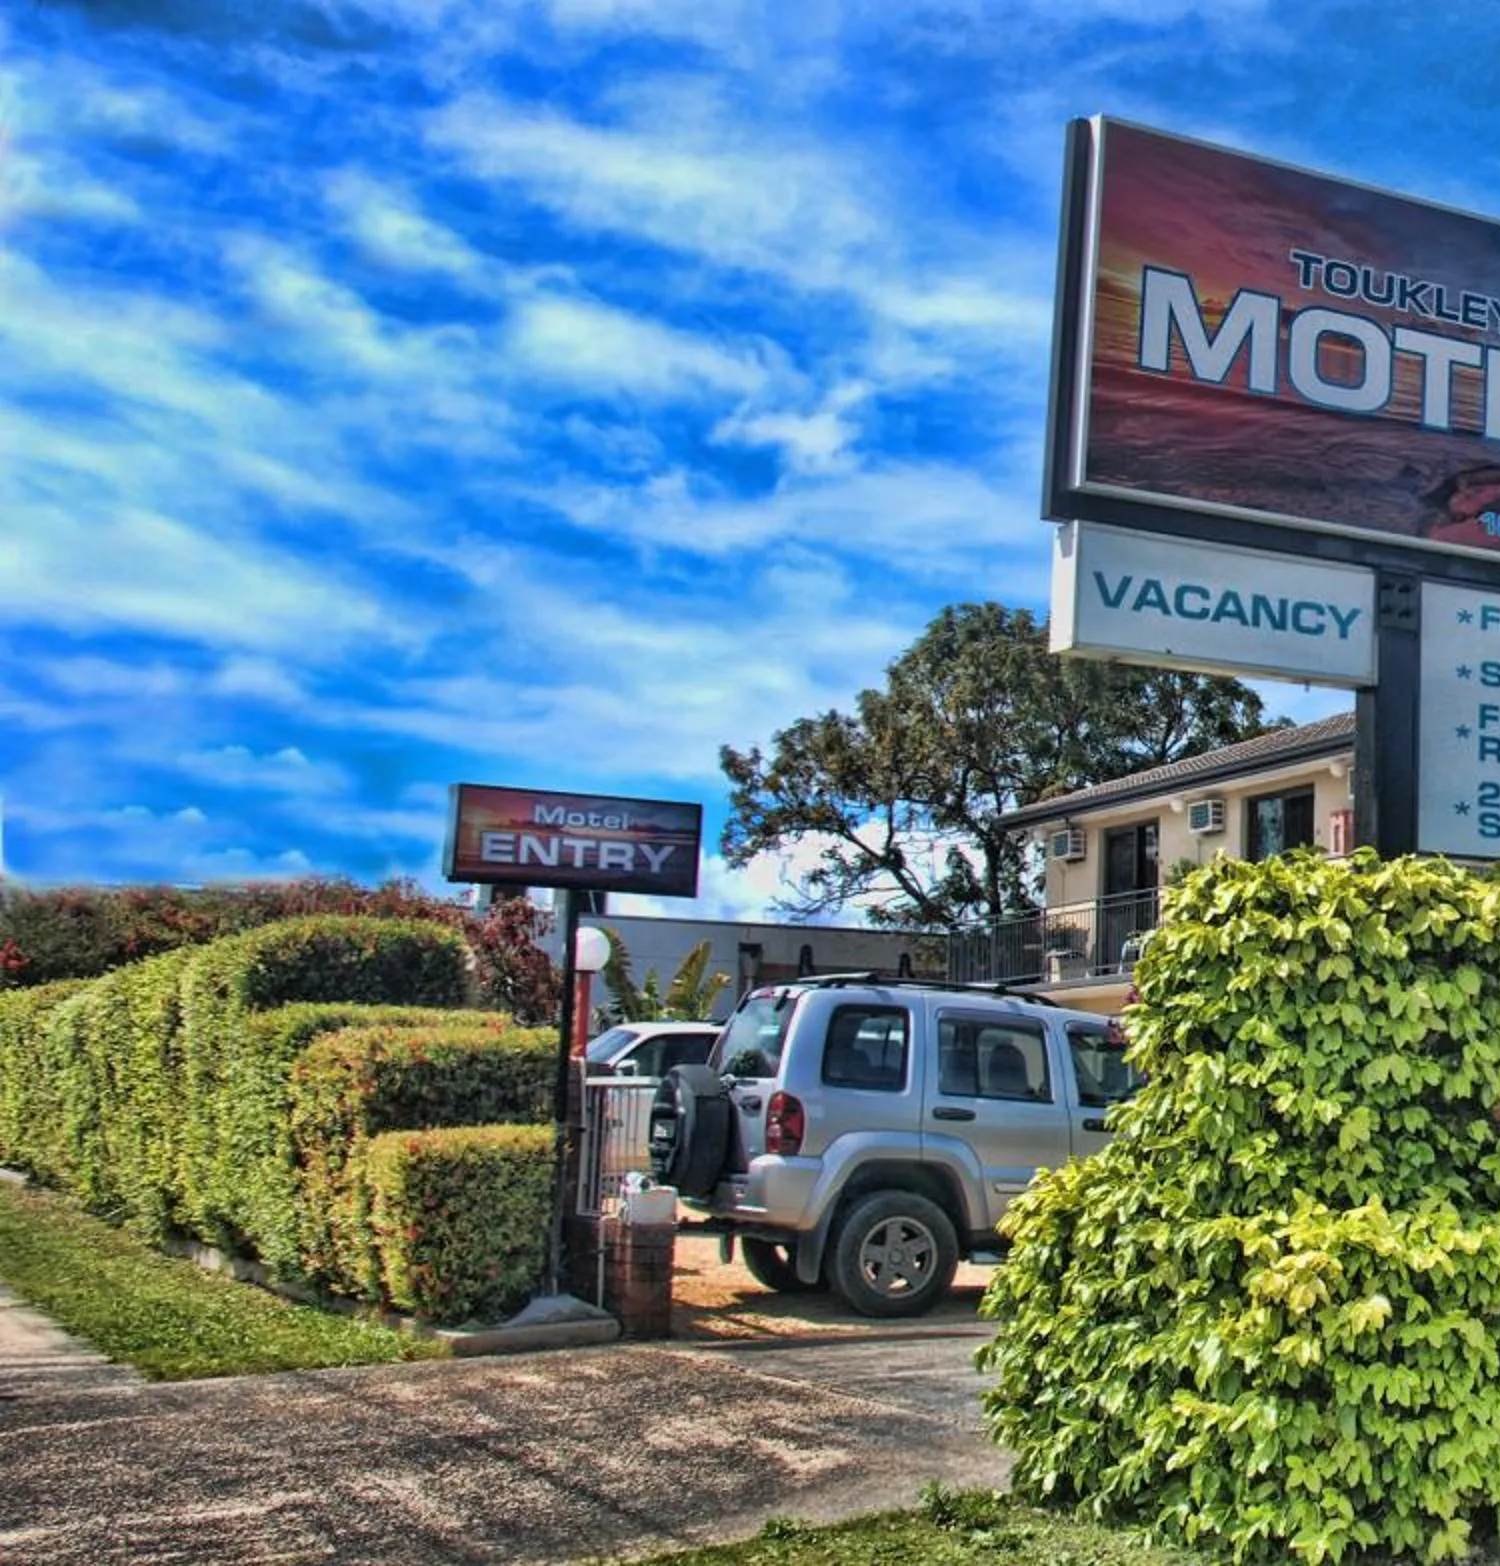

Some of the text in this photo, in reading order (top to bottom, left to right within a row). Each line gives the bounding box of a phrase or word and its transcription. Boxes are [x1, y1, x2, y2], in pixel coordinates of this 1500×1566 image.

[1094, 572, 1361, 640] VACANCY
[533, 804, 630, 831] Motel
[481, 831, 675, 874] ENTRY
